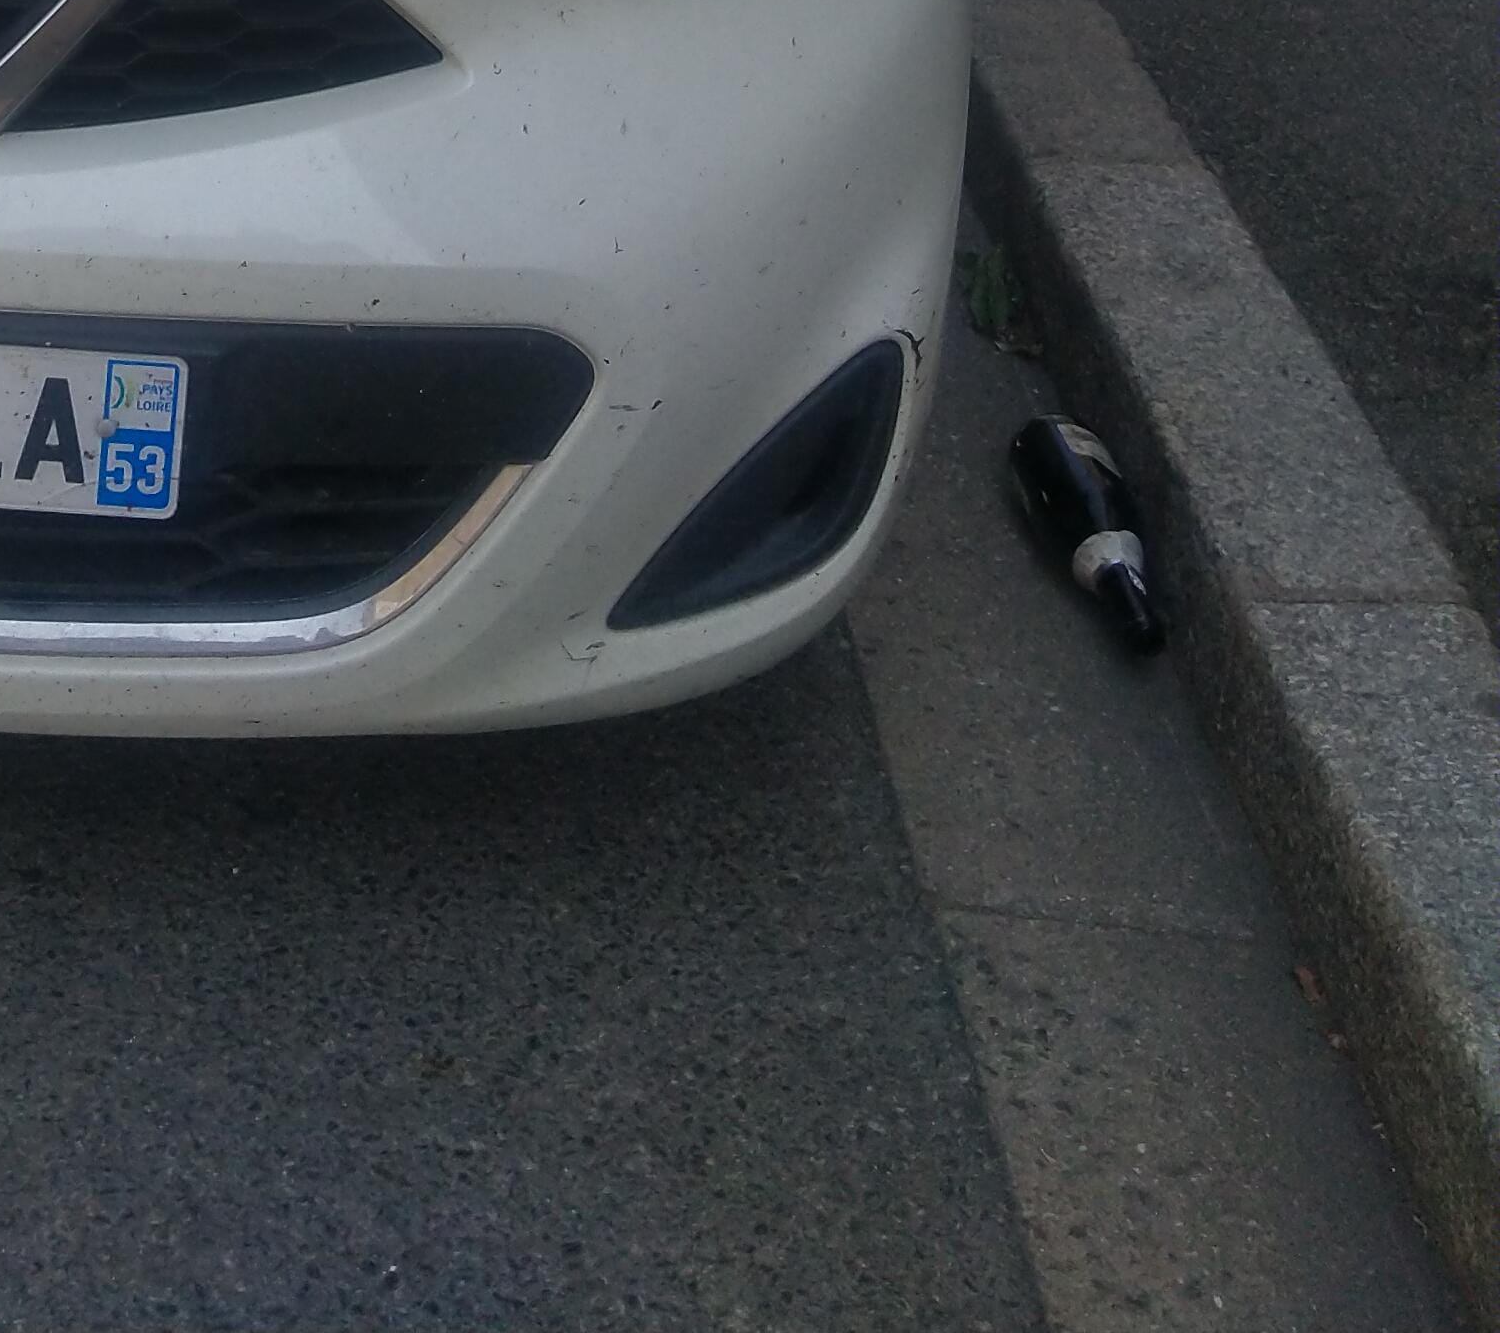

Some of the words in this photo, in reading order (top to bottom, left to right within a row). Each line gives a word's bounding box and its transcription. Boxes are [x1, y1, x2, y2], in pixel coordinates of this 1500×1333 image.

[141, 384, 173, 396] PAYS
[136, 400, 172, 413] LOIRE
[105, 442, 166, 496] 53
